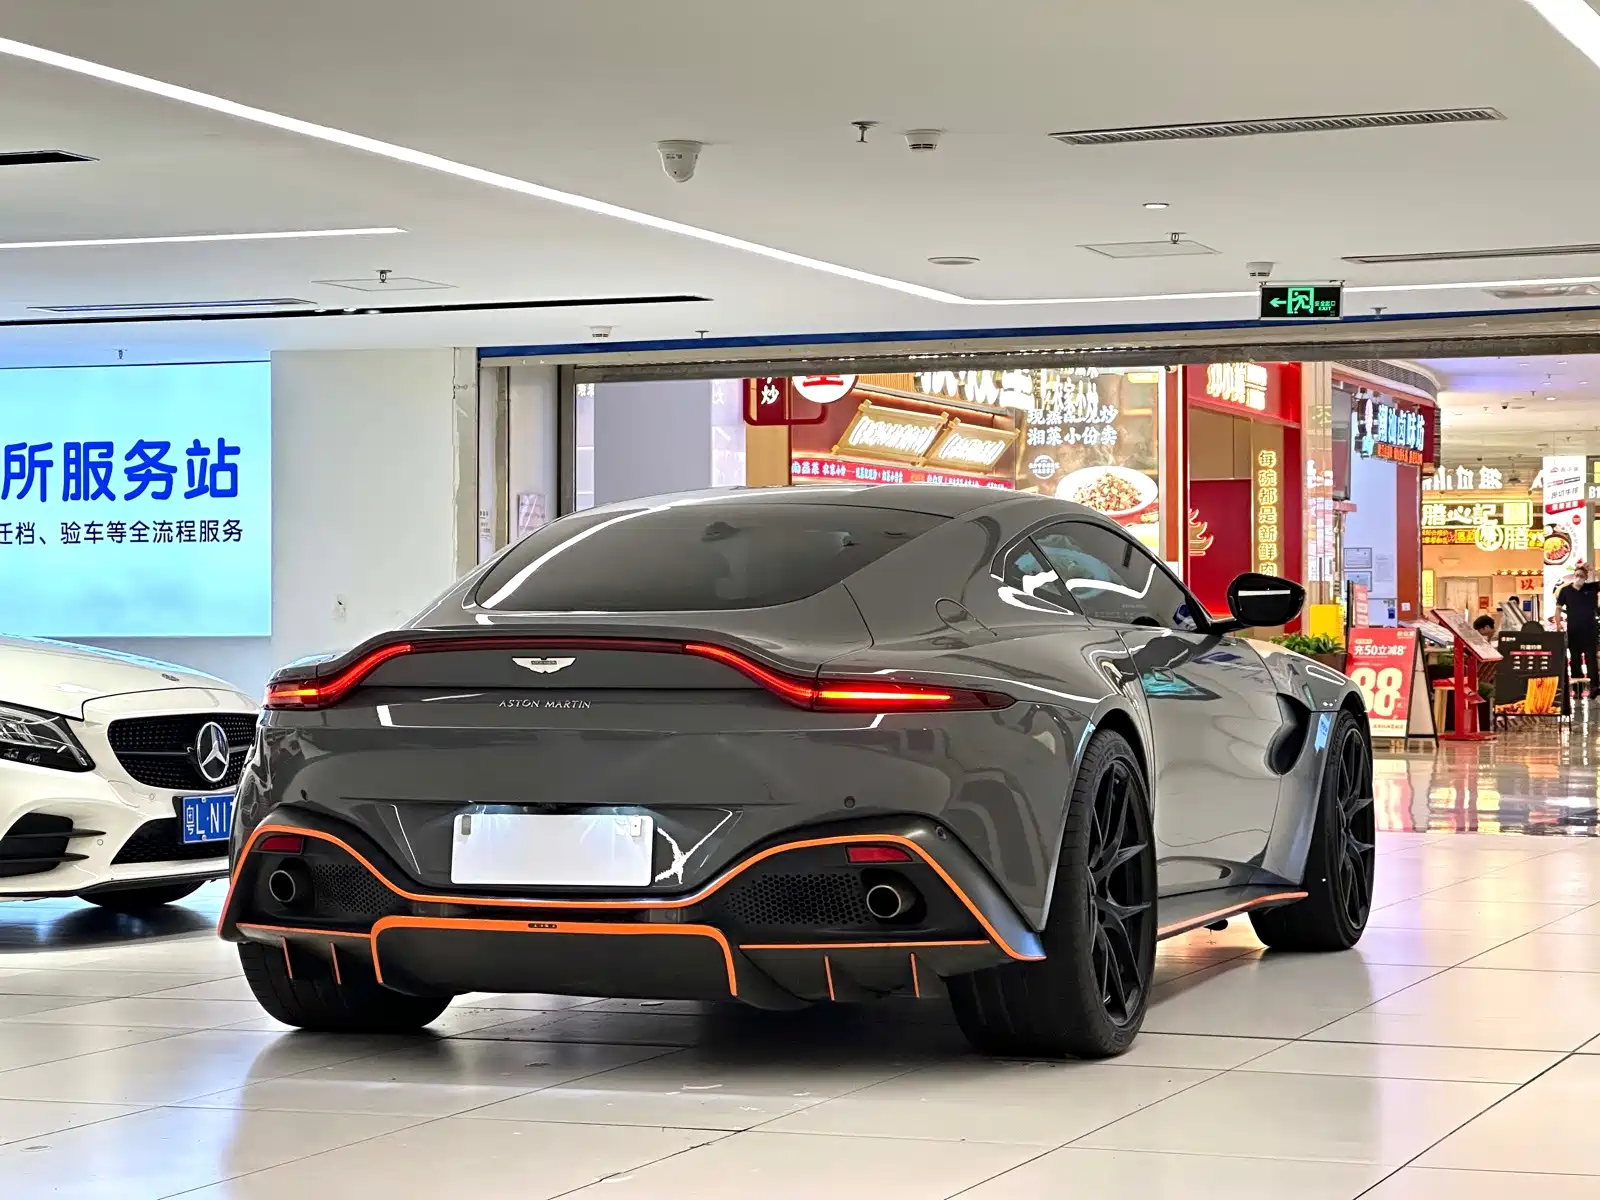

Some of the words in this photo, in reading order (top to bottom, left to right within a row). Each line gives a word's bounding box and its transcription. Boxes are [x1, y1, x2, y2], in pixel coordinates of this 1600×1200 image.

[1026, 425, 1118, 446] 湘菜小份卖
[0, 437, 241, 503] 所服务站
[1258, 450, 1278, 577] 每碗都是新鲜肉
[0, 518, 243, 545] 迁档、验车等全流程服务
[499, 699, 540, 709] ASTON
[545, 699, 592, 709] MARTIN
